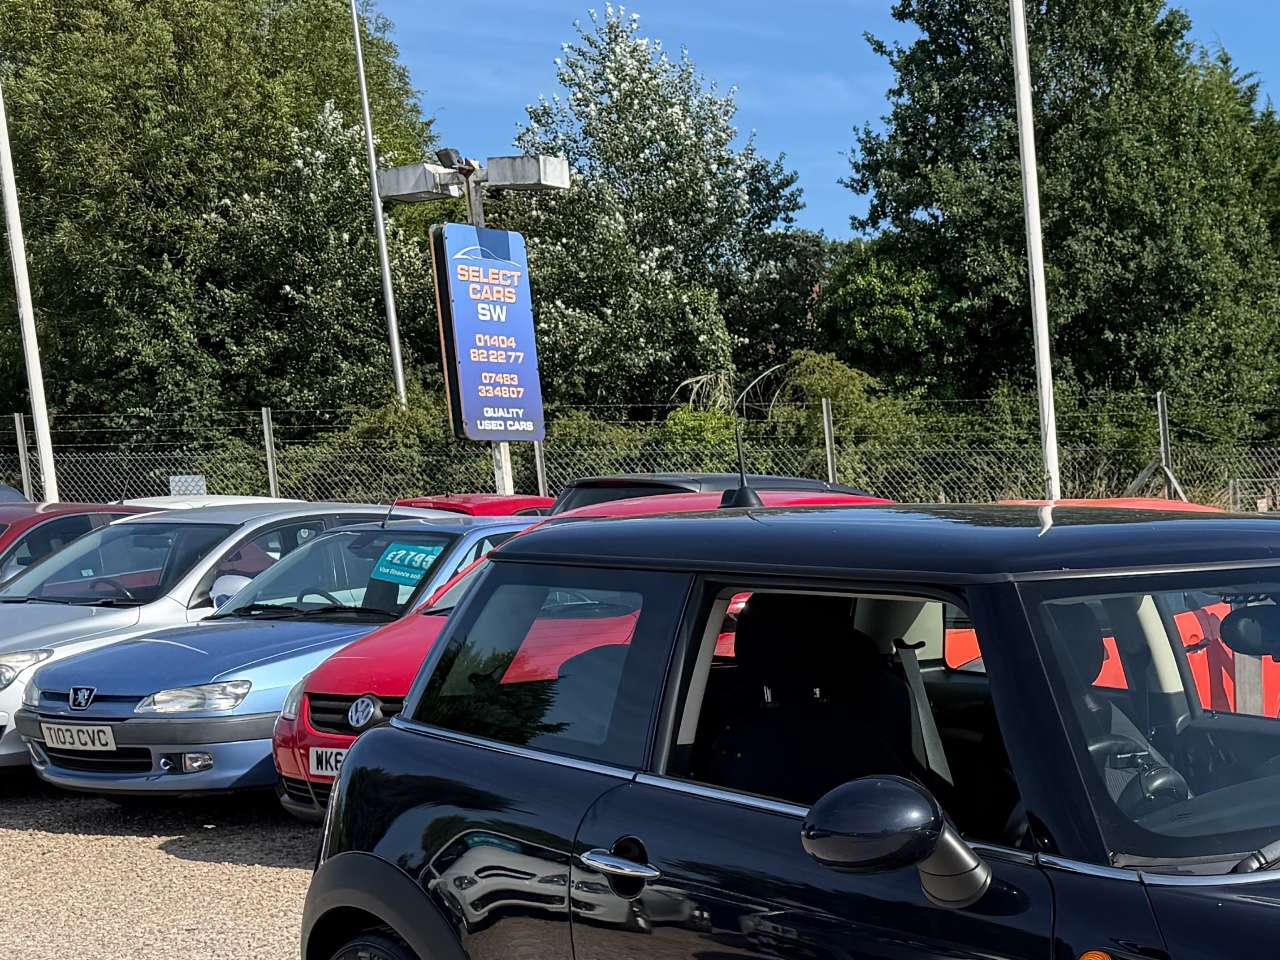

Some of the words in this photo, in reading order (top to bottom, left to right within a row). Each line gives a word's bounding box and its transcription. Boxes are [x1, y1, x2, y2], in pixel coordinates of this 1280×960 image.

[457, 264, 521, 286] SELECT
[469, 283, 516, 304] CARS
[478, 303, 507, 322] SW
[475, 334, 516, 348] 01404
[483, 407, 524, 418] QUALITY
[477, 420, 505, 430] USED
[506, 420, 534, 431] CARS
[76, 728, 109, 747] CVC
